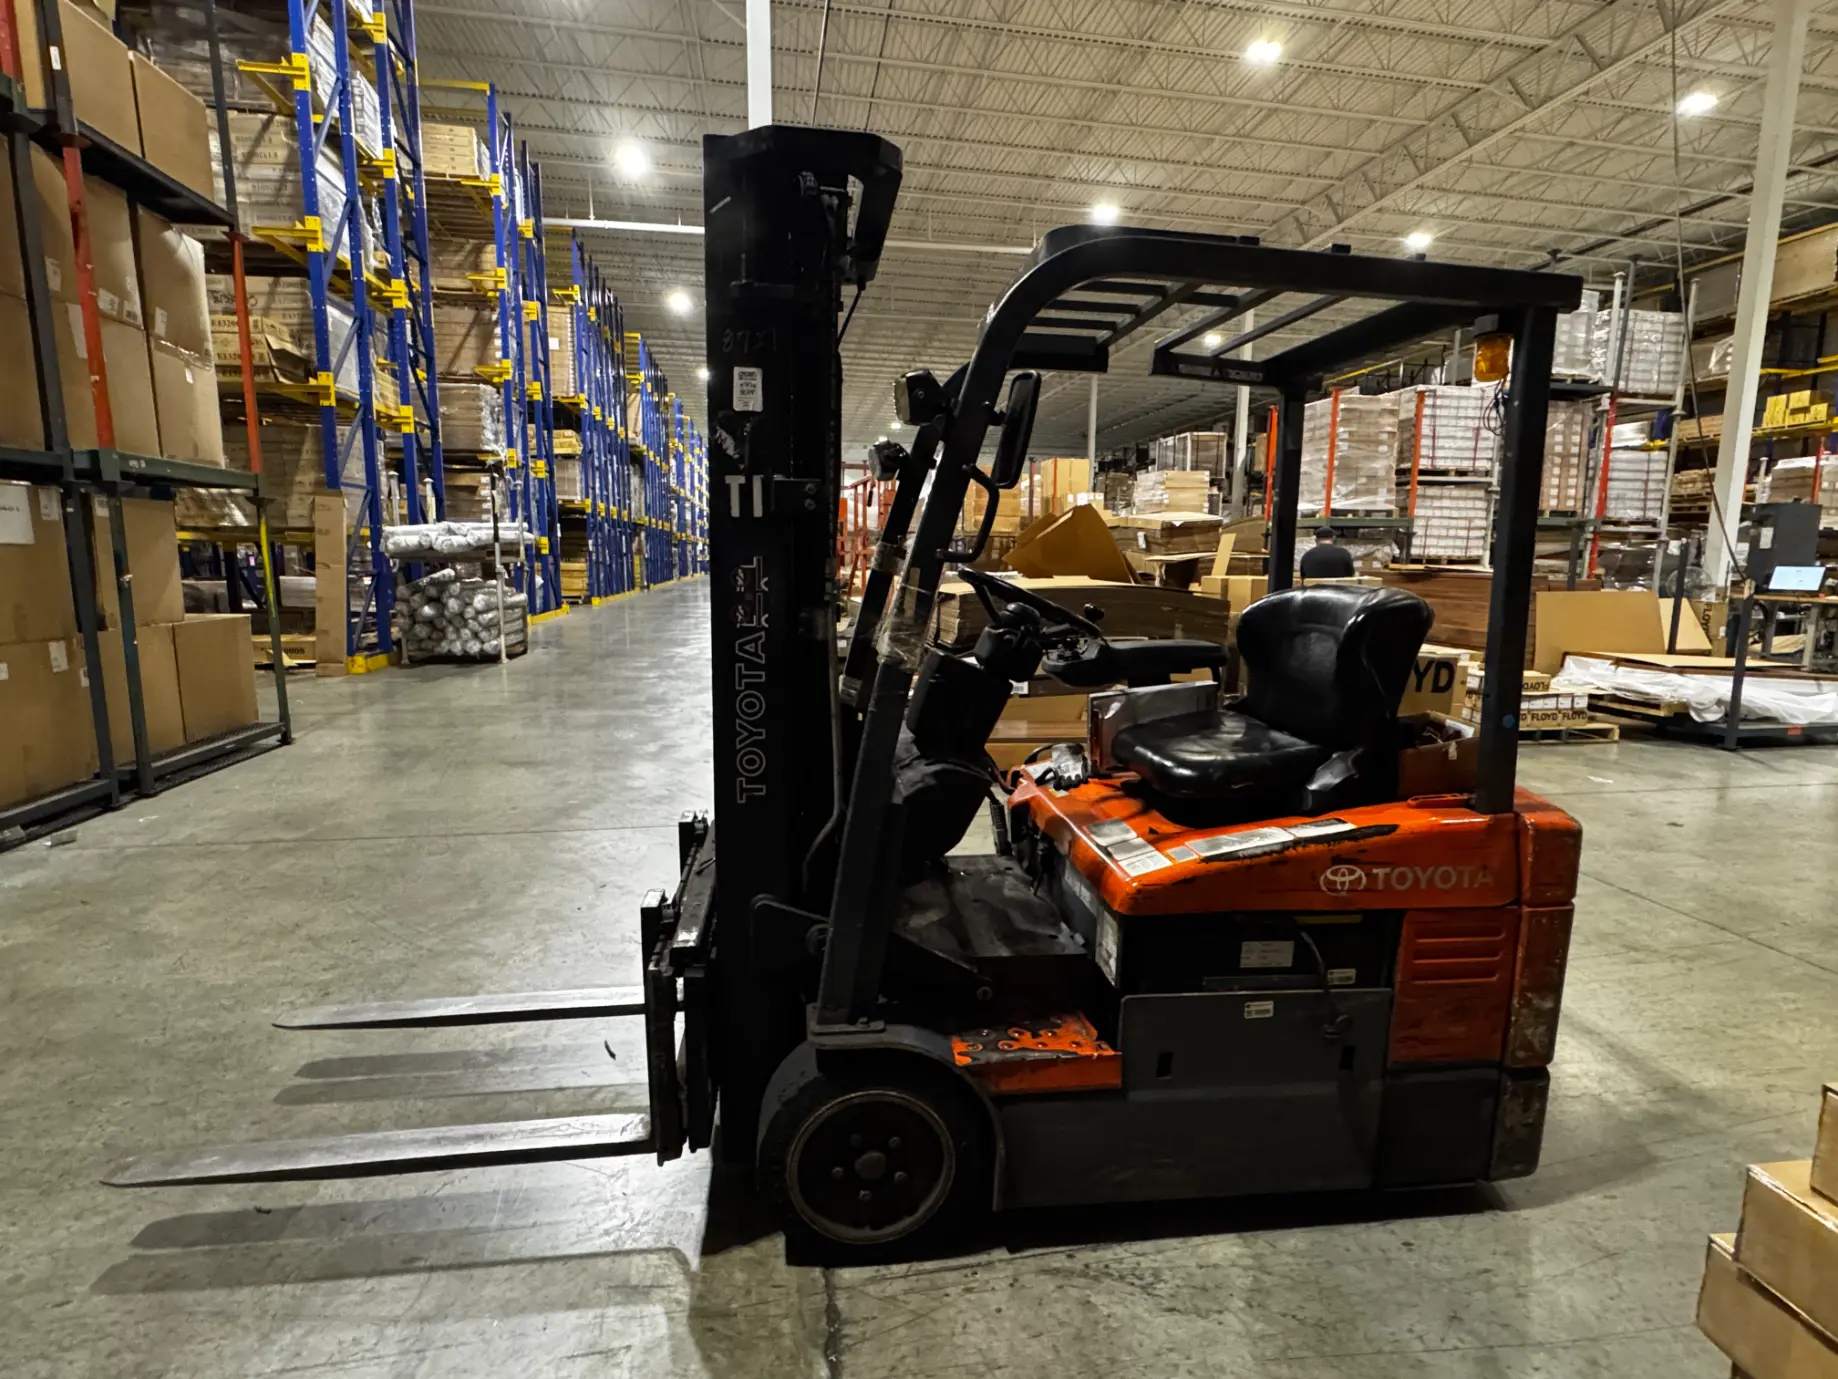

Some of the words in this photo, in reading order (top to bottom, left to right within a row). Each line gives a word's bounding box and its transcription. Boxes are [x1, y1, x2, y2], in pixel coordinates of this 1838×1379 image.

[735, 631, 767, 804] TOYOTA
[1531, 712, 1558, 721] FLOYD
[1562, 710, 1588, 721] FLOYD
[1371, 865, 1494, 891] TOYOTA
